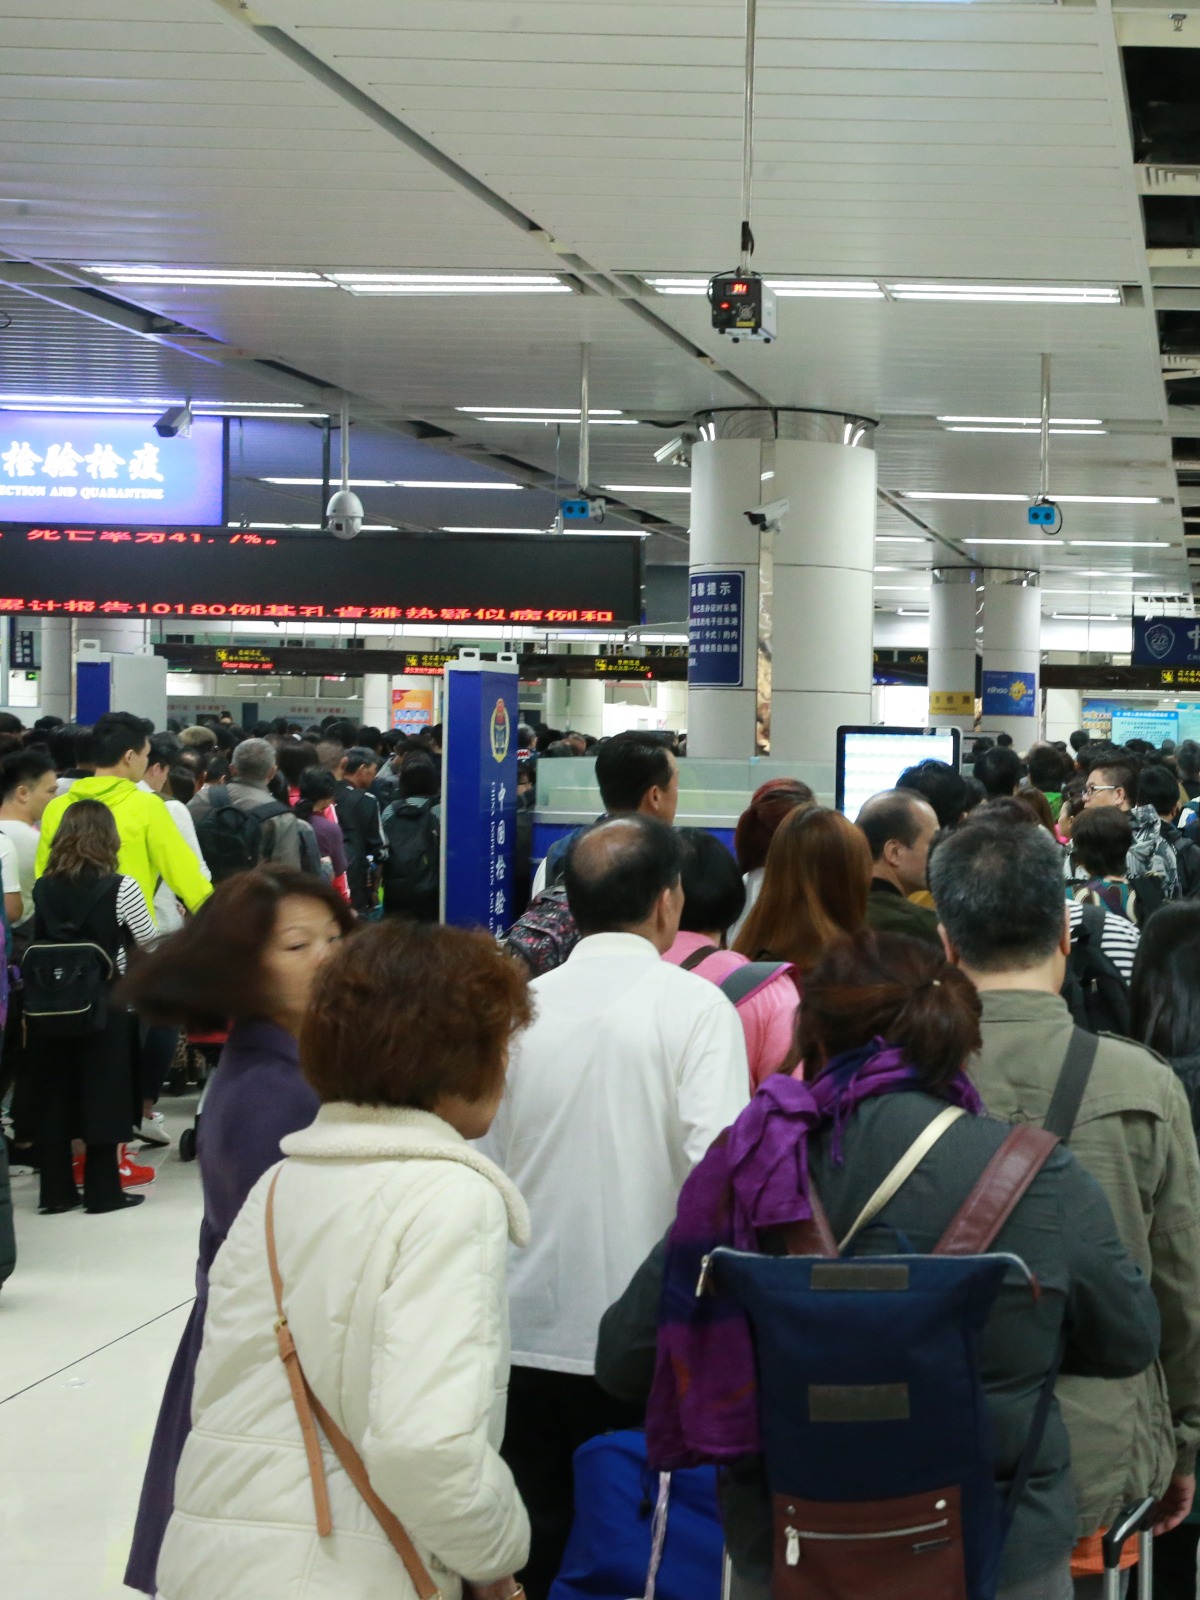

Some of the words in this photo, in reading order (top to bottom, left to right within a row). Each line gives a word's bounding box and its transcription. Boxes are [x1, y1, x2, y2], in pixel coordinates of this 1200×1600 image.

[1, 440, 165, 482] 检验检疫
[49, 486, 78, 498] AND
[80, 487, 164, 500] QUARANTINE
